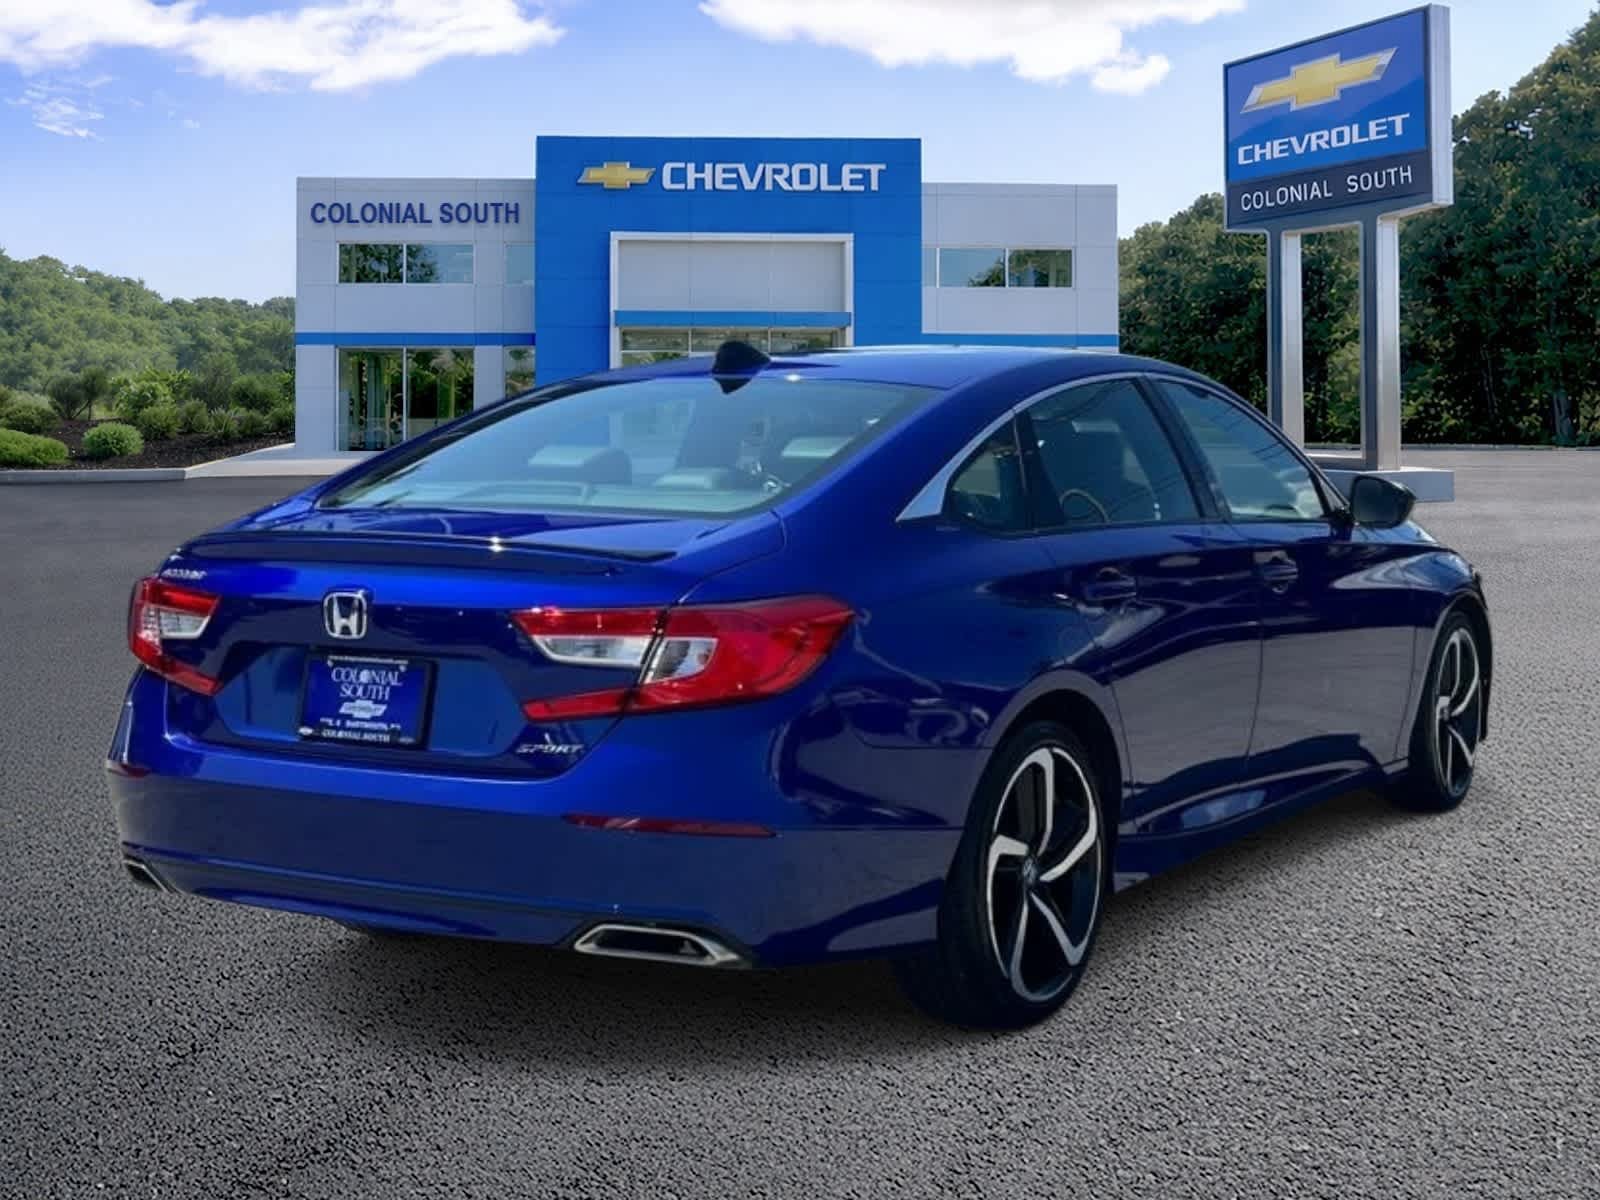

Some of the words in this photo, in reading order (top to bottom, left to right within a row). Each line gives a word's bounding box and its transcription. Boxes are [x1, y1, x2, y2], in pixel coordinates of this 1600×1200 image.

[1237, 112, 1410, 165] CHEVROLET
[661, 161, 887, 192] CHEVROLET
[1240, 179, 1333, 212] COLONIAL
[1346, 164, 1413, 193] SOUTH
[310, 202, 432, 225] COLONIAL
[439, 202, 520, 225] SOUTH
[331, 667, 403, 687] COLONIAL
[340, 682, 391, 701] SOUTH
[516, 743, 583, 754] SPORT
